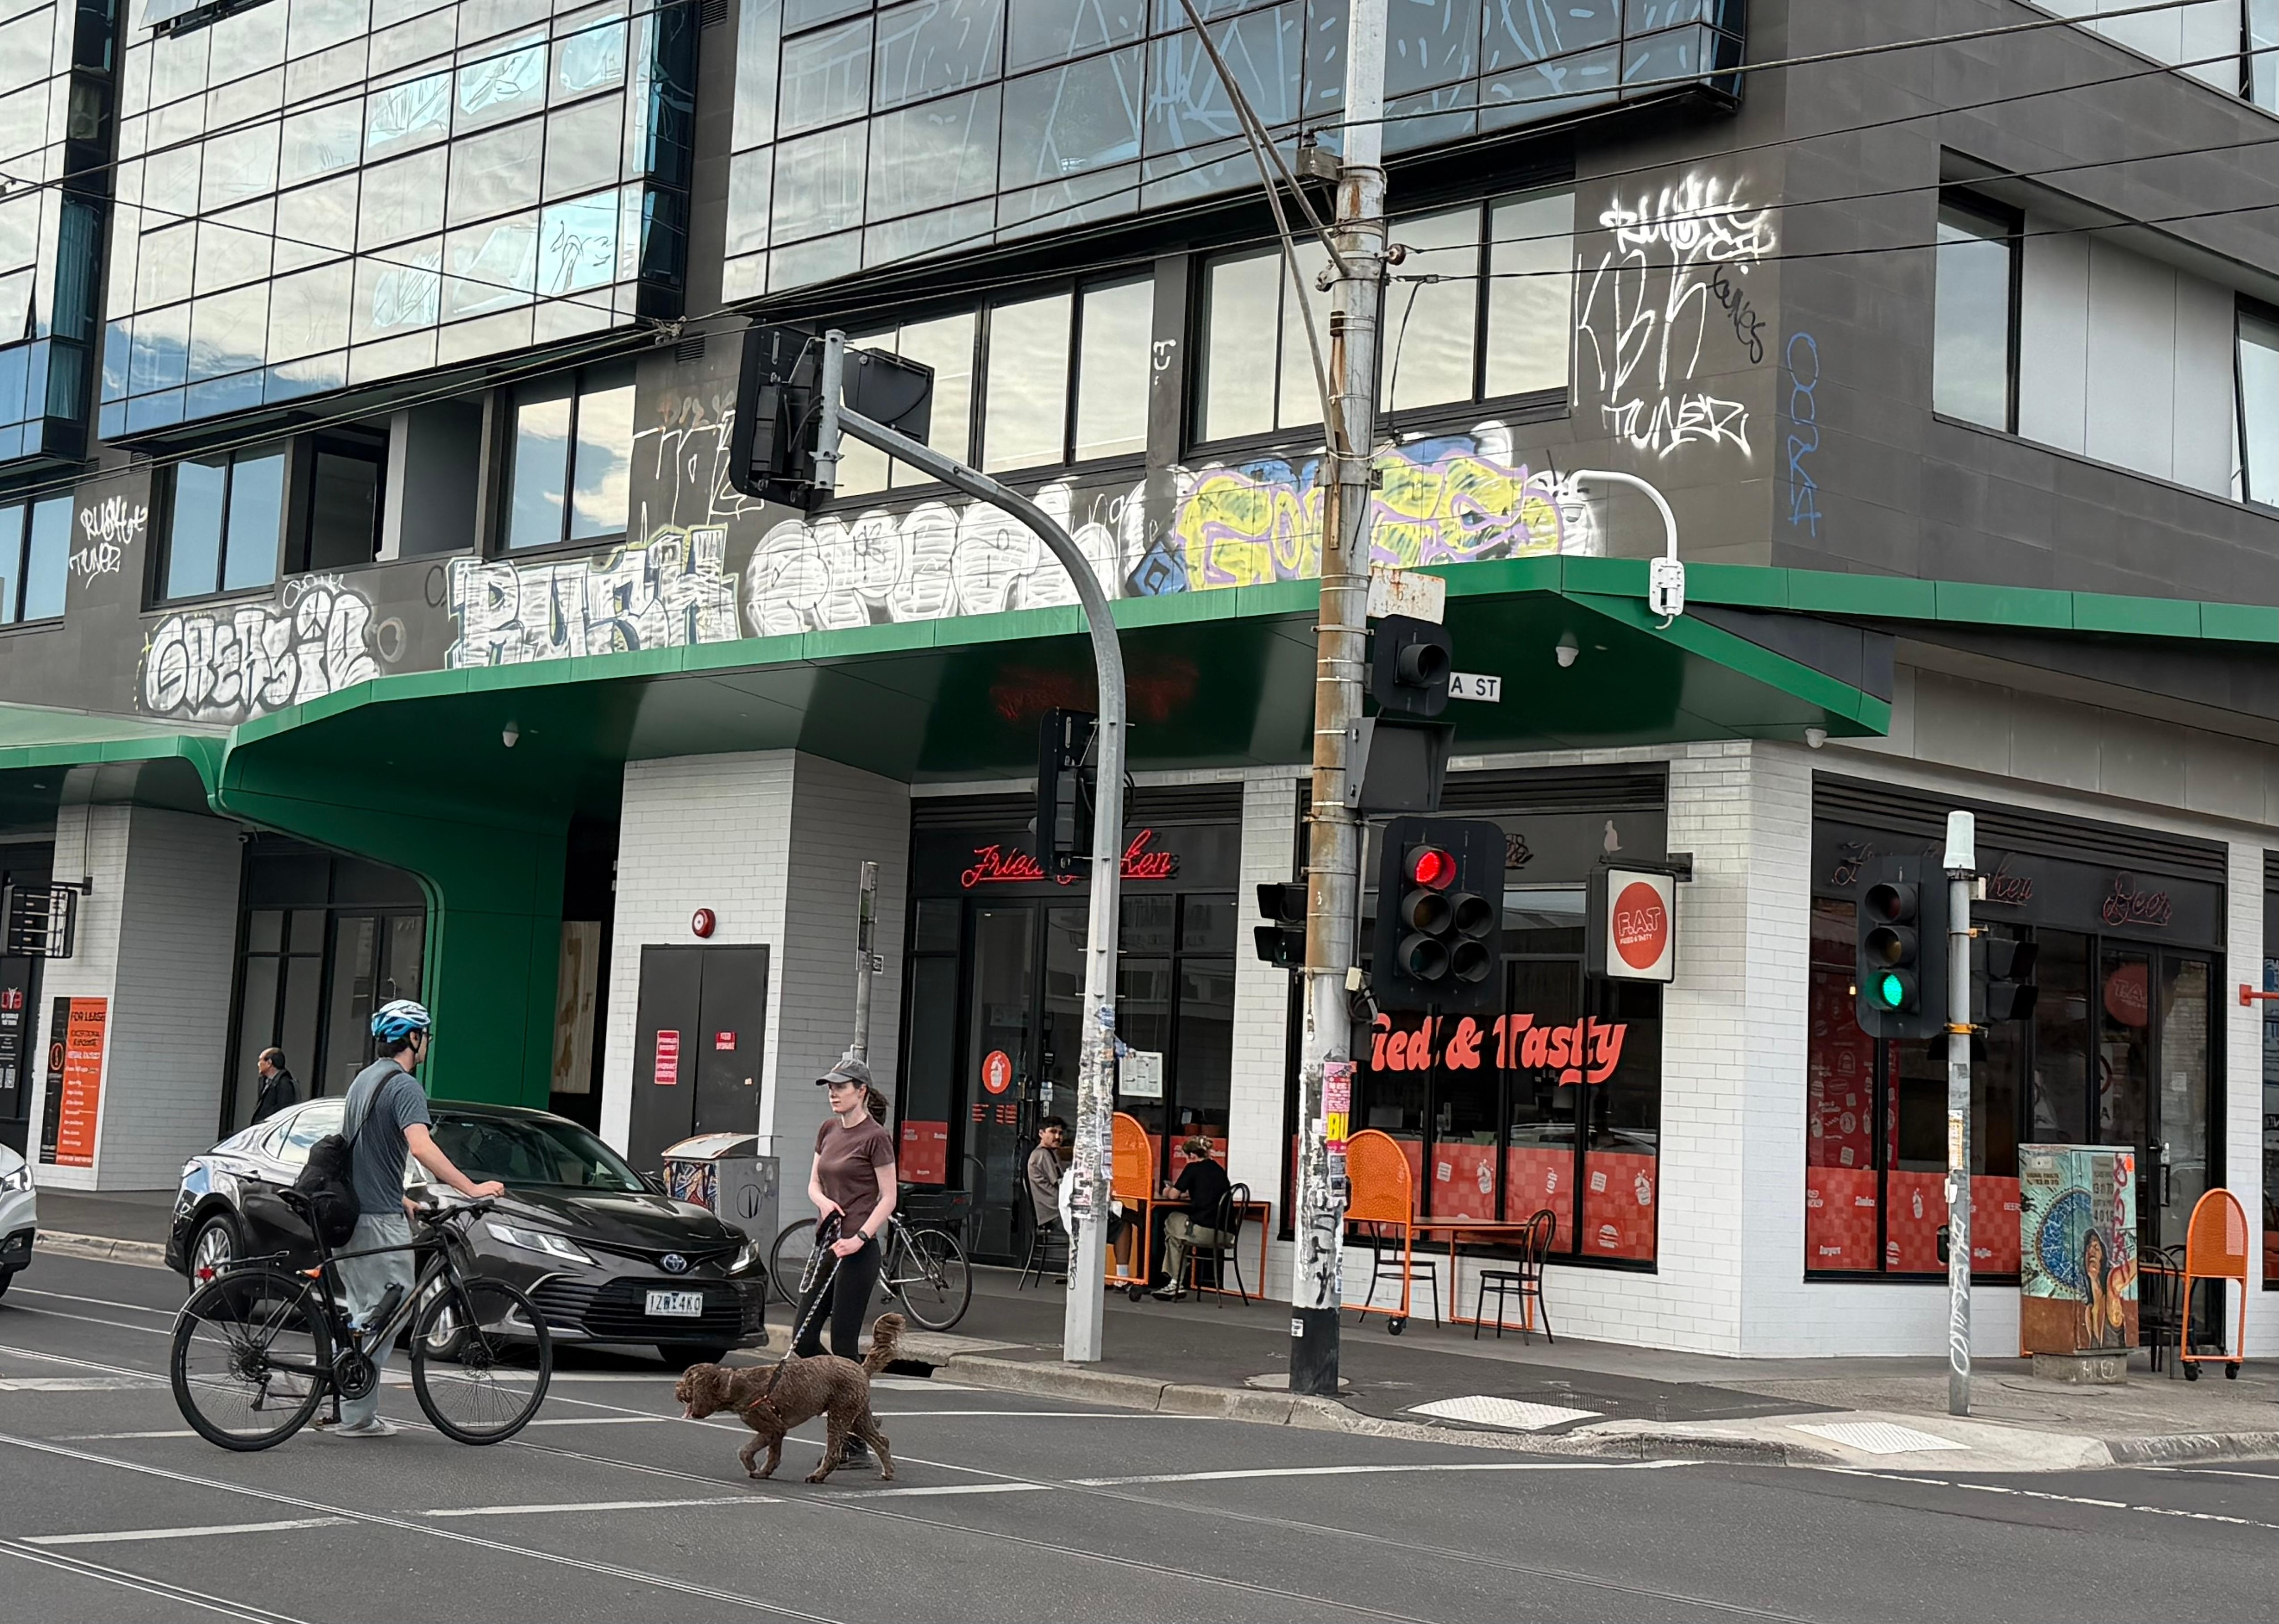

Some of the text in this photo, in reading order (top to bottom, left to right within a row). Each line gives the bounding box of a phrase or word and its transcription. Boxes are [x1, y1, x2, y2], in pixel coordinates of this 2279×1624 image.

[1476, 678, 1497, 697] ST
[1372, 1012, 1628, 1088] ied & Tasty
